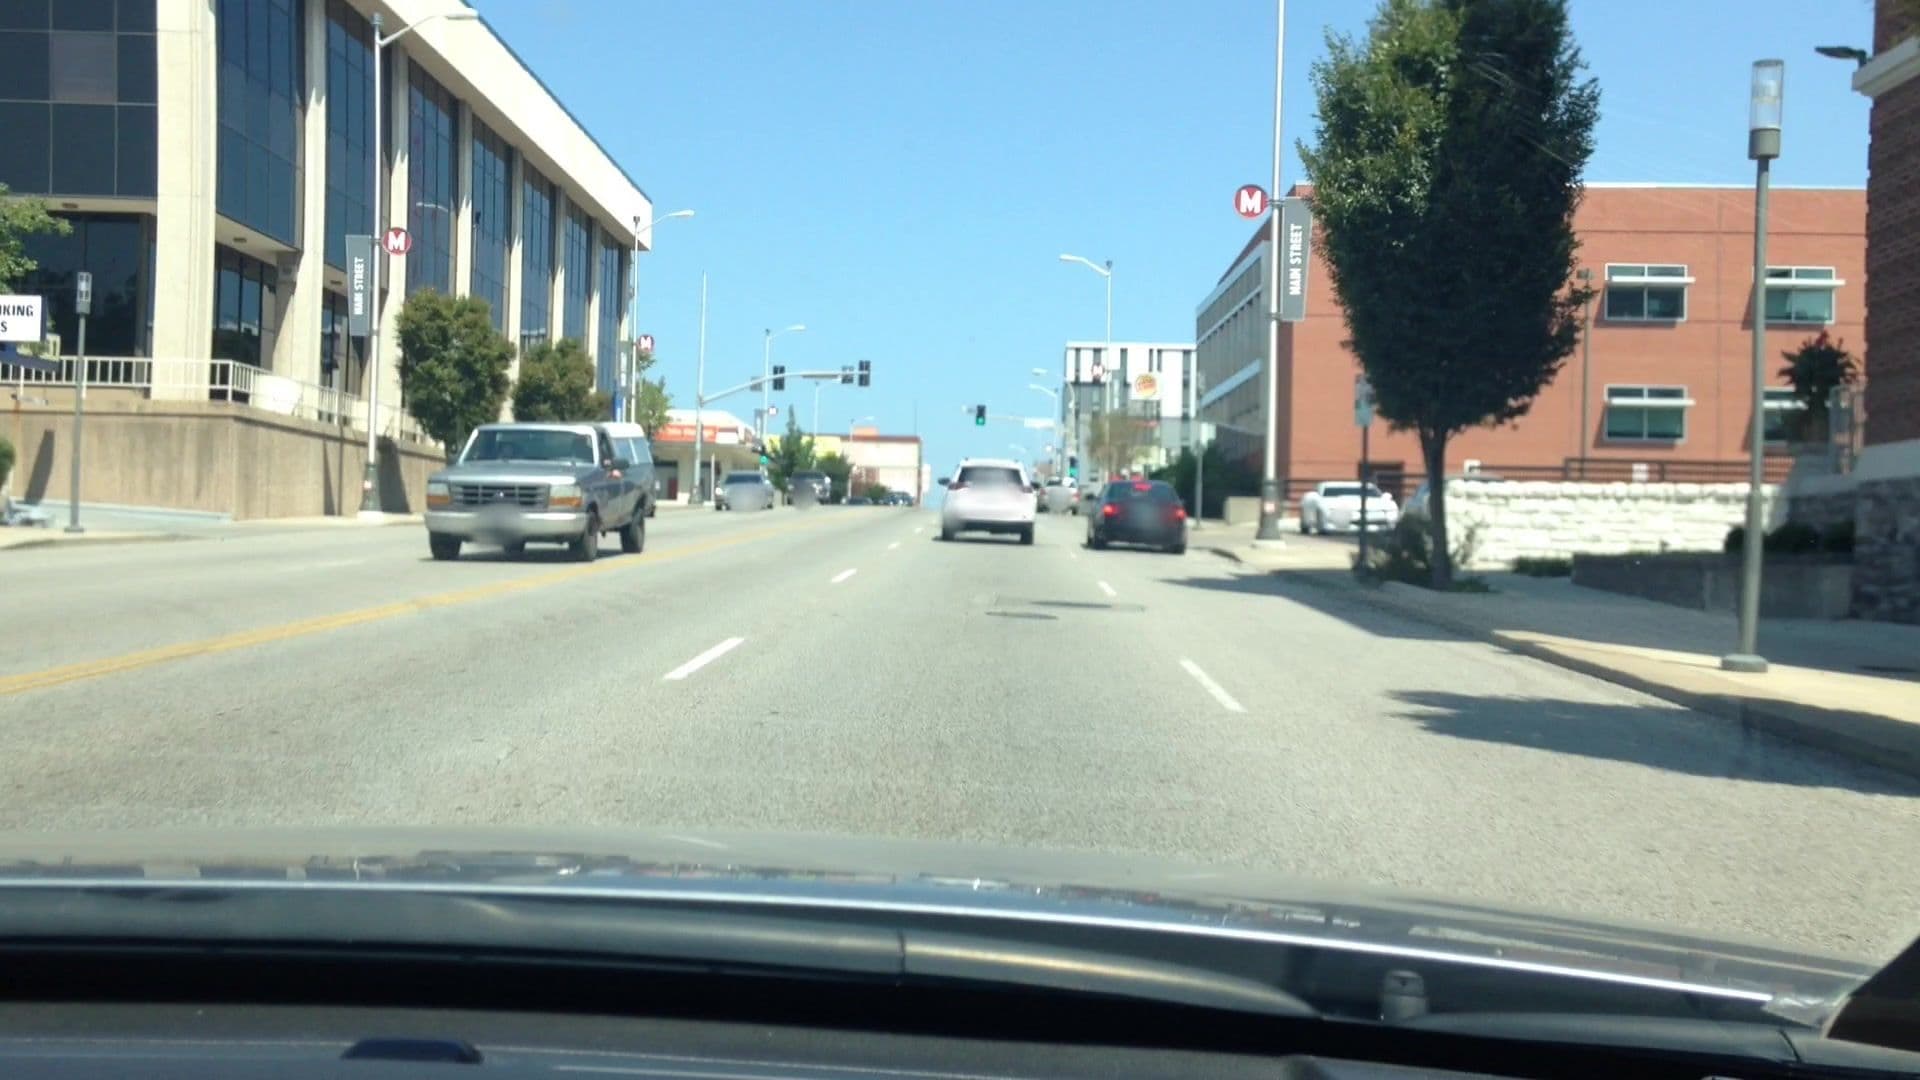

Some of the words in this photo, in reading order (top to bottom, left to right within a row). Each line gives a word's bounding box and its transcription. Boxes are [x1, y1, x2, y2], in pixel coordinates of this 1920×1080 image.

[1240, 189, 1262, 214] M
[388, 231, 407, 251] M
[1289, 223, 1303, 265] STREET
[354, 256, 365, 291] STREET
[1289, 268, 1302, 296] MAIN
[353, 292, 364, 316] MAIN
